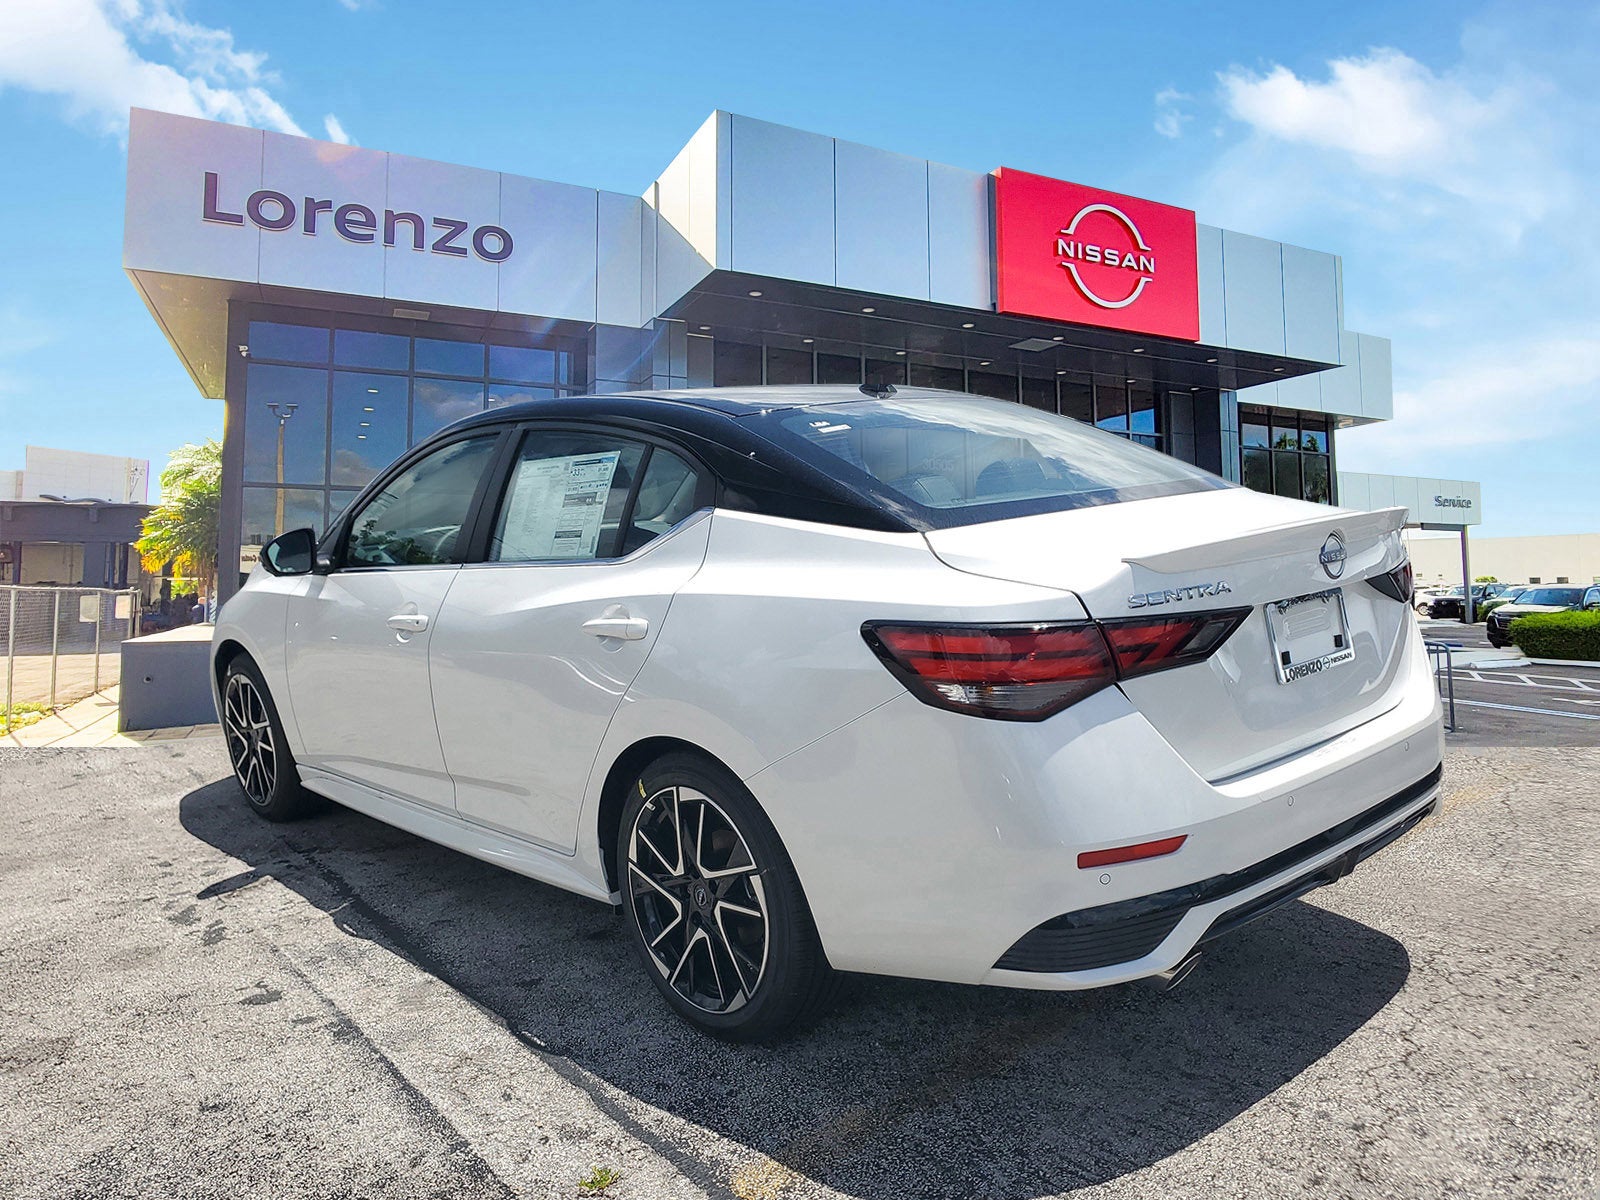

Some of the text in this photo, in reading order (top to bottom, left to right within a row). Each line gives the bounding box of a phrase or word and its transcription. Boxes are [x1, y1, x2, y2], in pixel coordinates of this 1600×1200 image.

[202, 171, 514, 262] Lorenzo
[1057, 238, 1155, 273] NISSAN
[1434, 495, 1472, 509] Service
[1128, 580, 1232, 609] SENTRA
[1284, 652, 1352, 682] LORENZO NISSAN
